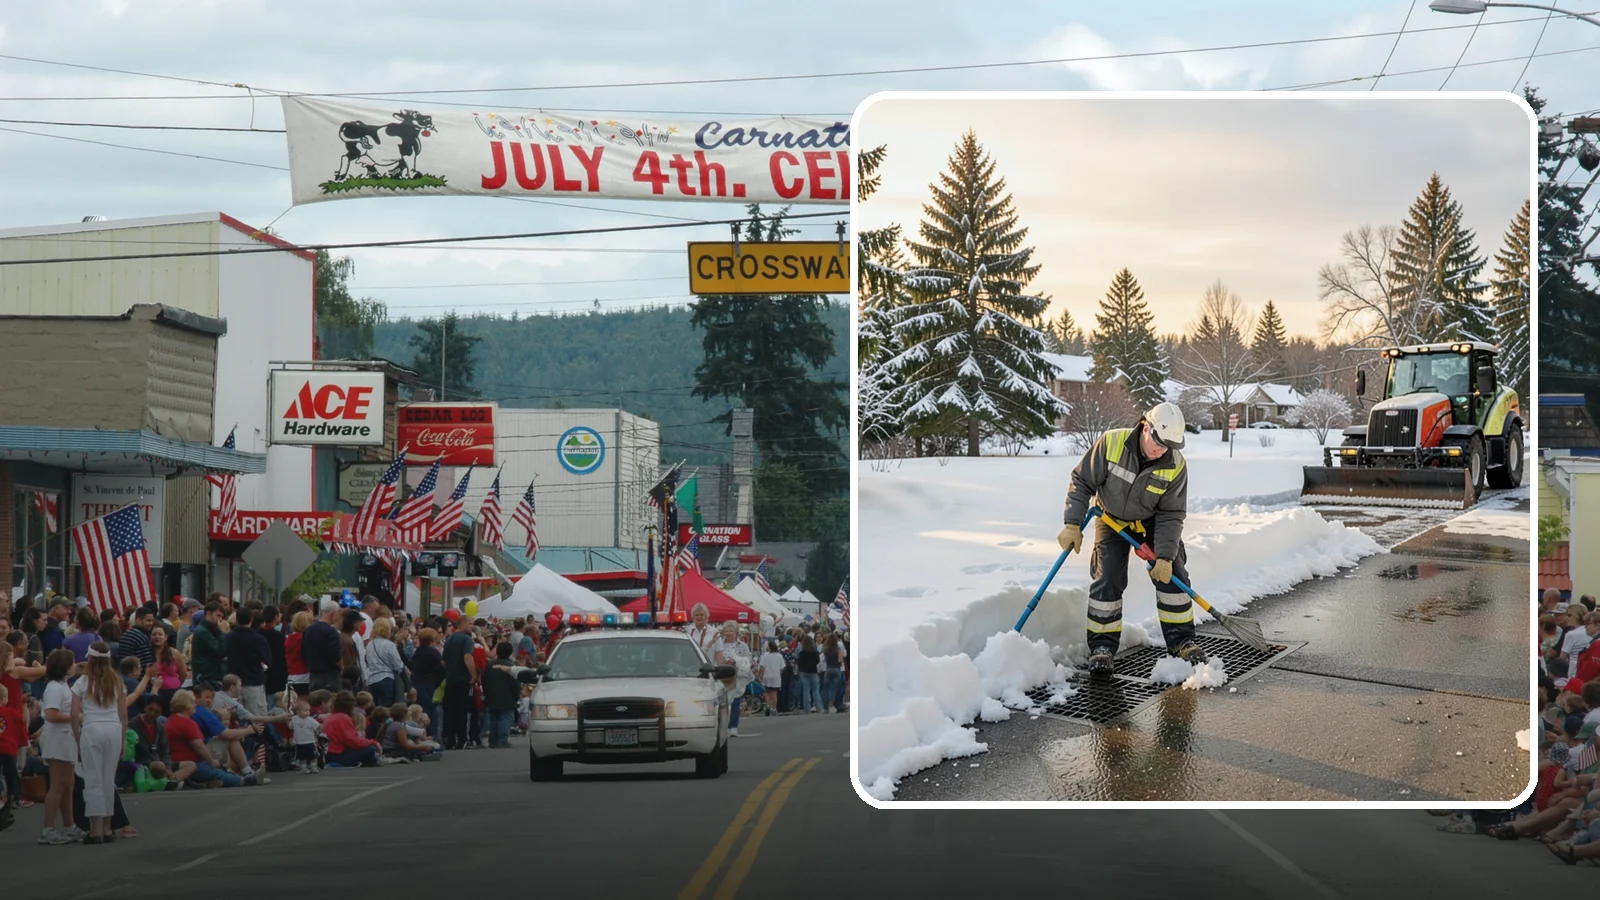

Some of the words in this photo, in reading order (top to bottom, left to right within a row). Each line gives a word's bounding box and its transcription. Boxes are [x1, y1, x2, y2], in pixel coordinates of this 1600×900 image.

[695, 121, 850, 149] Carnat
[480, 141, 605, 192] JULY
[632, 150, 746, 198] 4th.
[696, 254, 850, 280] CROSSWA
[283, 380, 373, 420] ACE
[405, 409, 452, 421] CEDAR
[283, 421, 371, 436] Hardware
[416, 428, 477, 447] Coca-Cola
[353, 467, 385, 480] Simpl
[95, 485, 124, 494] Vincent
[126, 486, 136, 494] de
[138, 486, 155, 495] Paul
[213, 516, 330, 535] HARDARE
[688, 526, 741, 535] CRNATION
[699, 535, 730, 543] GLASS
